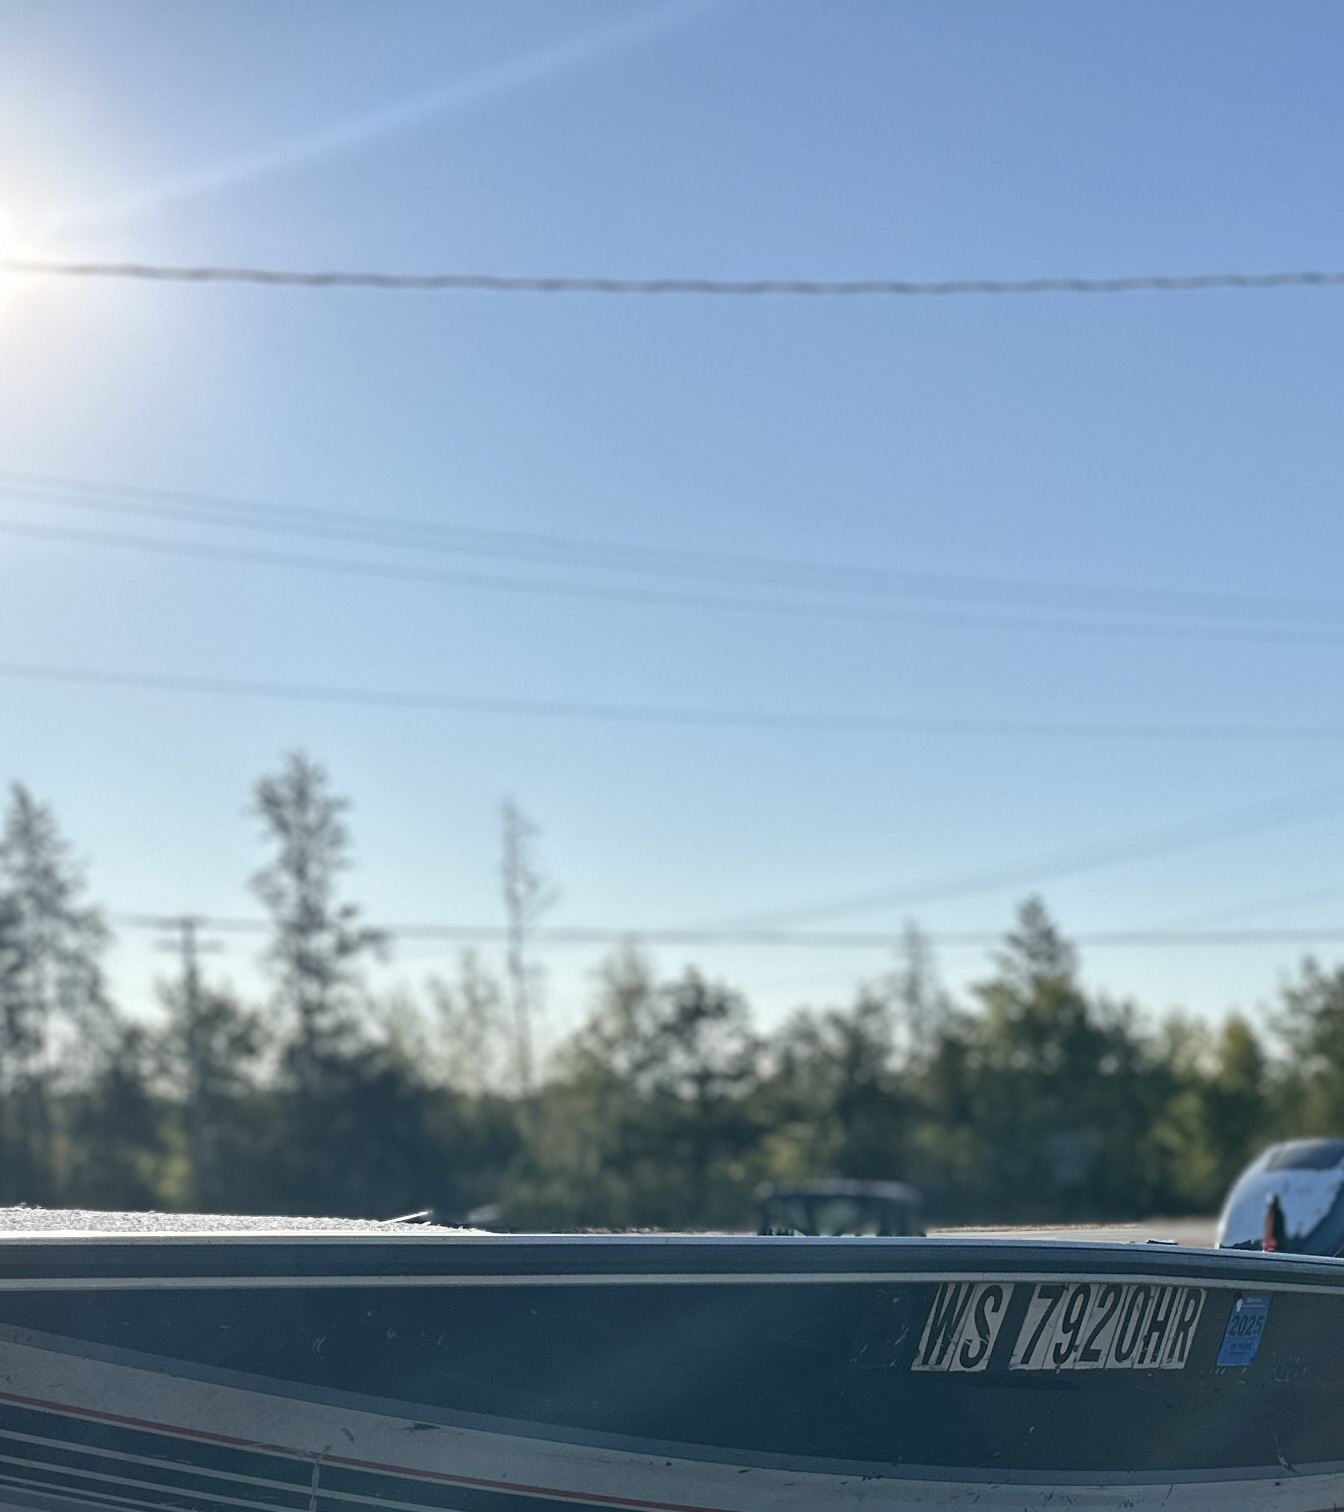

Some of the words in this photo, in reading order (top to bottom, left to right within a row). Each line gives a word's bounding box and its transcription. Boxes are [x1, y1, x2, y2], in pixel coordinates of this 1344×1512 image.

[919, 1283, 1004, 1368] WS
[1019, 1285, 1204, 1366] 7920HR
[1226, 1314, 1266, 1337] 2025
